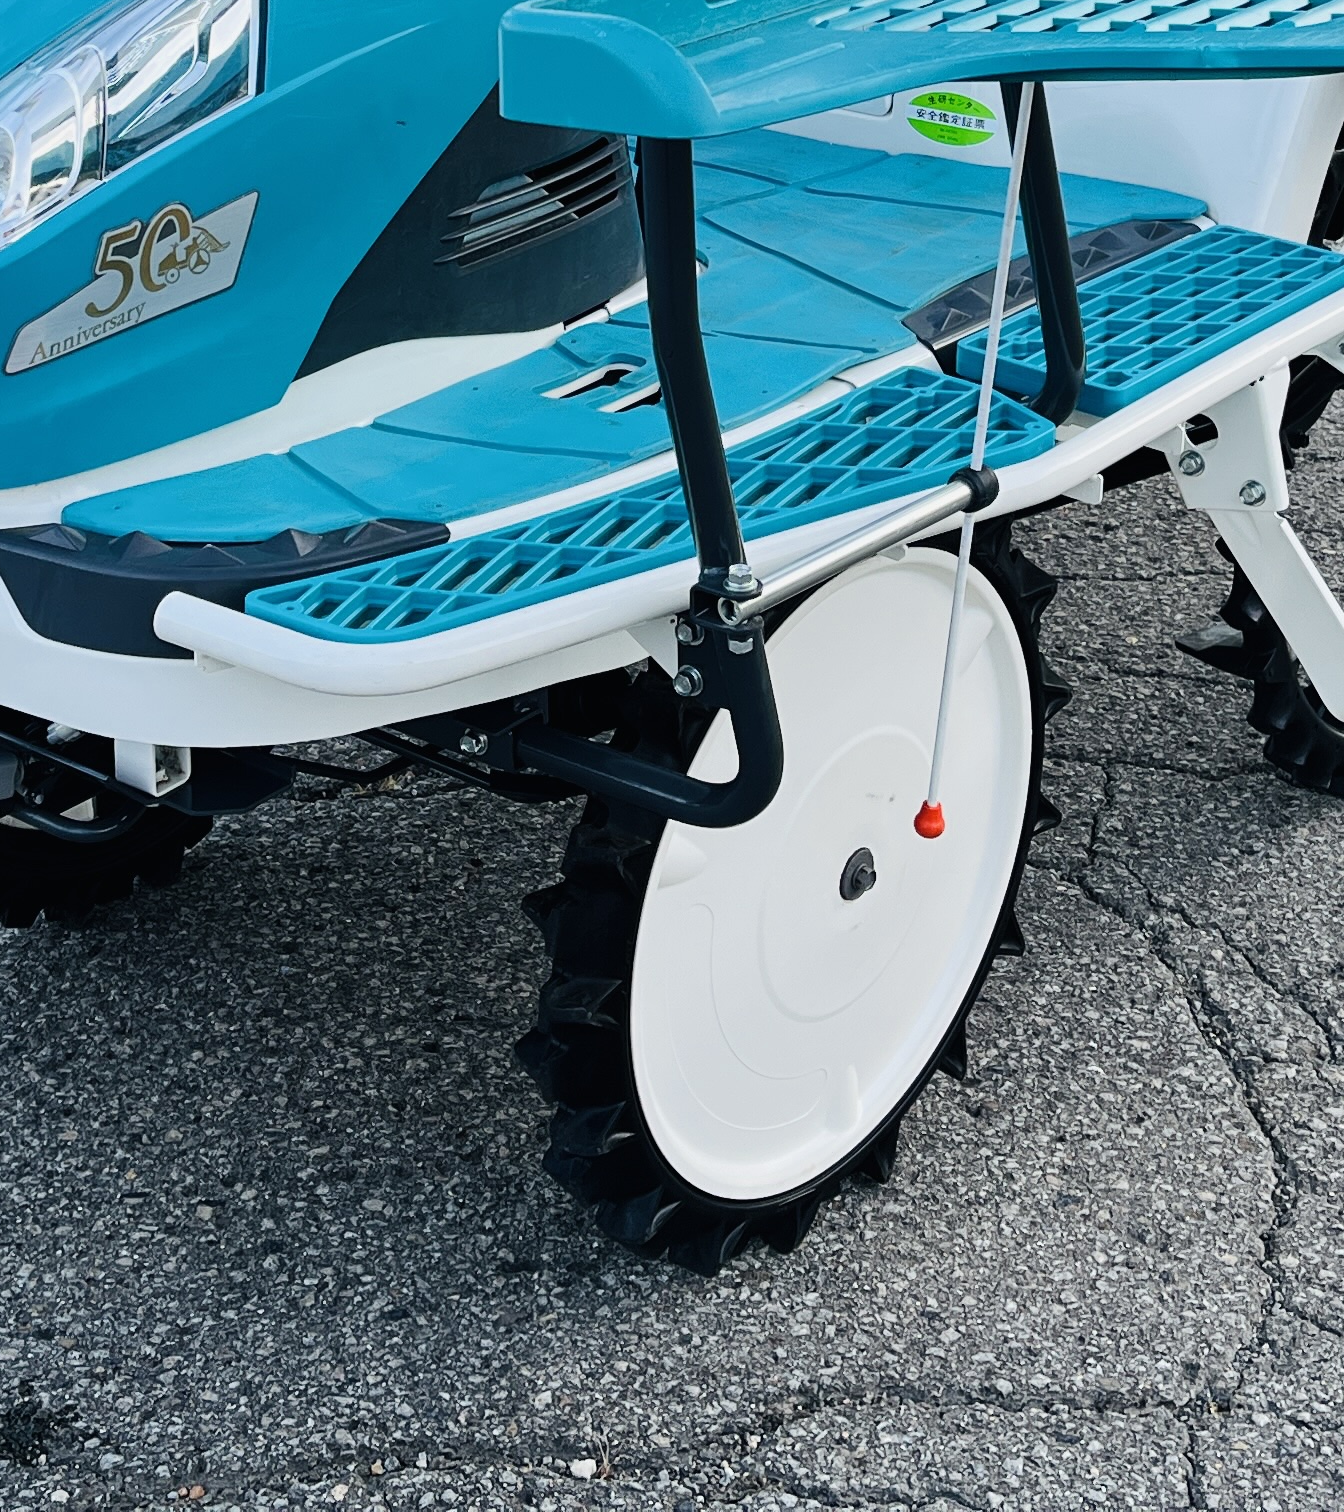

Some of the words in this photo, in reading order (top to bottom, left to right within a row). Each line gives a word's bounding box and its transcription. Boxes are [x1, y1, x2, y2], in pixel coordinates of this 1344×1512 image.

[916, 108, 986, 130] 安全鑑定証票
[928, 95, 981, 113] 生研センター
[85, 206, 192, 318] 50
[28, 301, 147, 365] Anniversary
